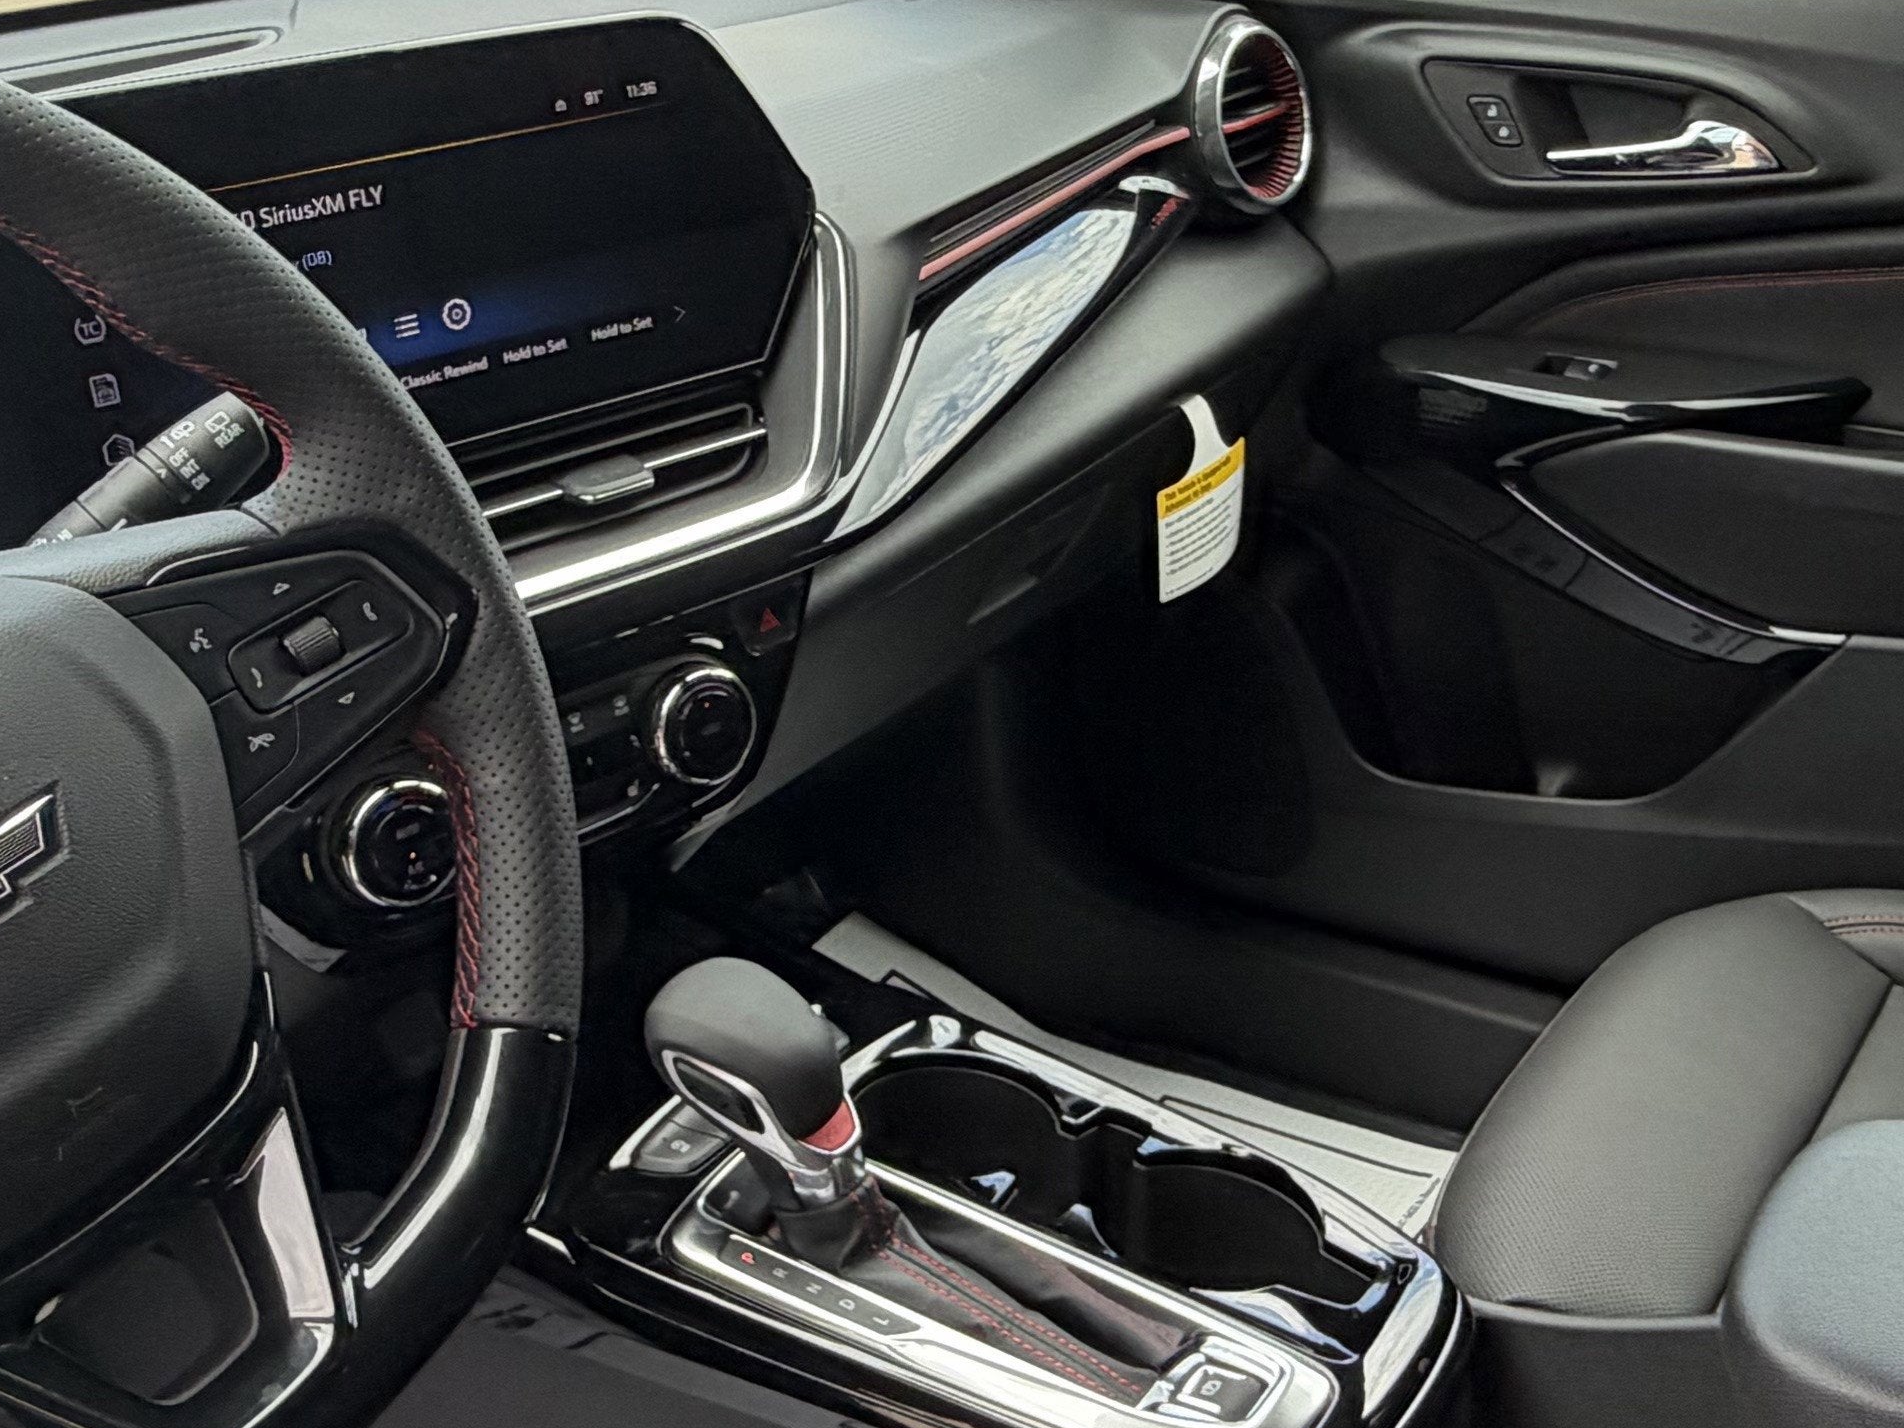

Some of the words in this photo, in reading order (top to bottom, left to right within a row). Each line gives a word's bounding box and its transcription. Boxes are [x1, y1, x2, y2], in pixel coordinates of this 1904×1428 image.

[259, 192, 346, 229] SiriusXM
[348, 184, 383, 210] FLY
[591, 324, 618, 341] Hold
[633, 316, 653, 332] Set
[400, 370, 443, 390] Classic
[444, 356, 489, 381] Rewind
[503, 346, 532, 364] Hold
[547, 338, 569, 354] Set
[168, 446, 190, 468] OFF
